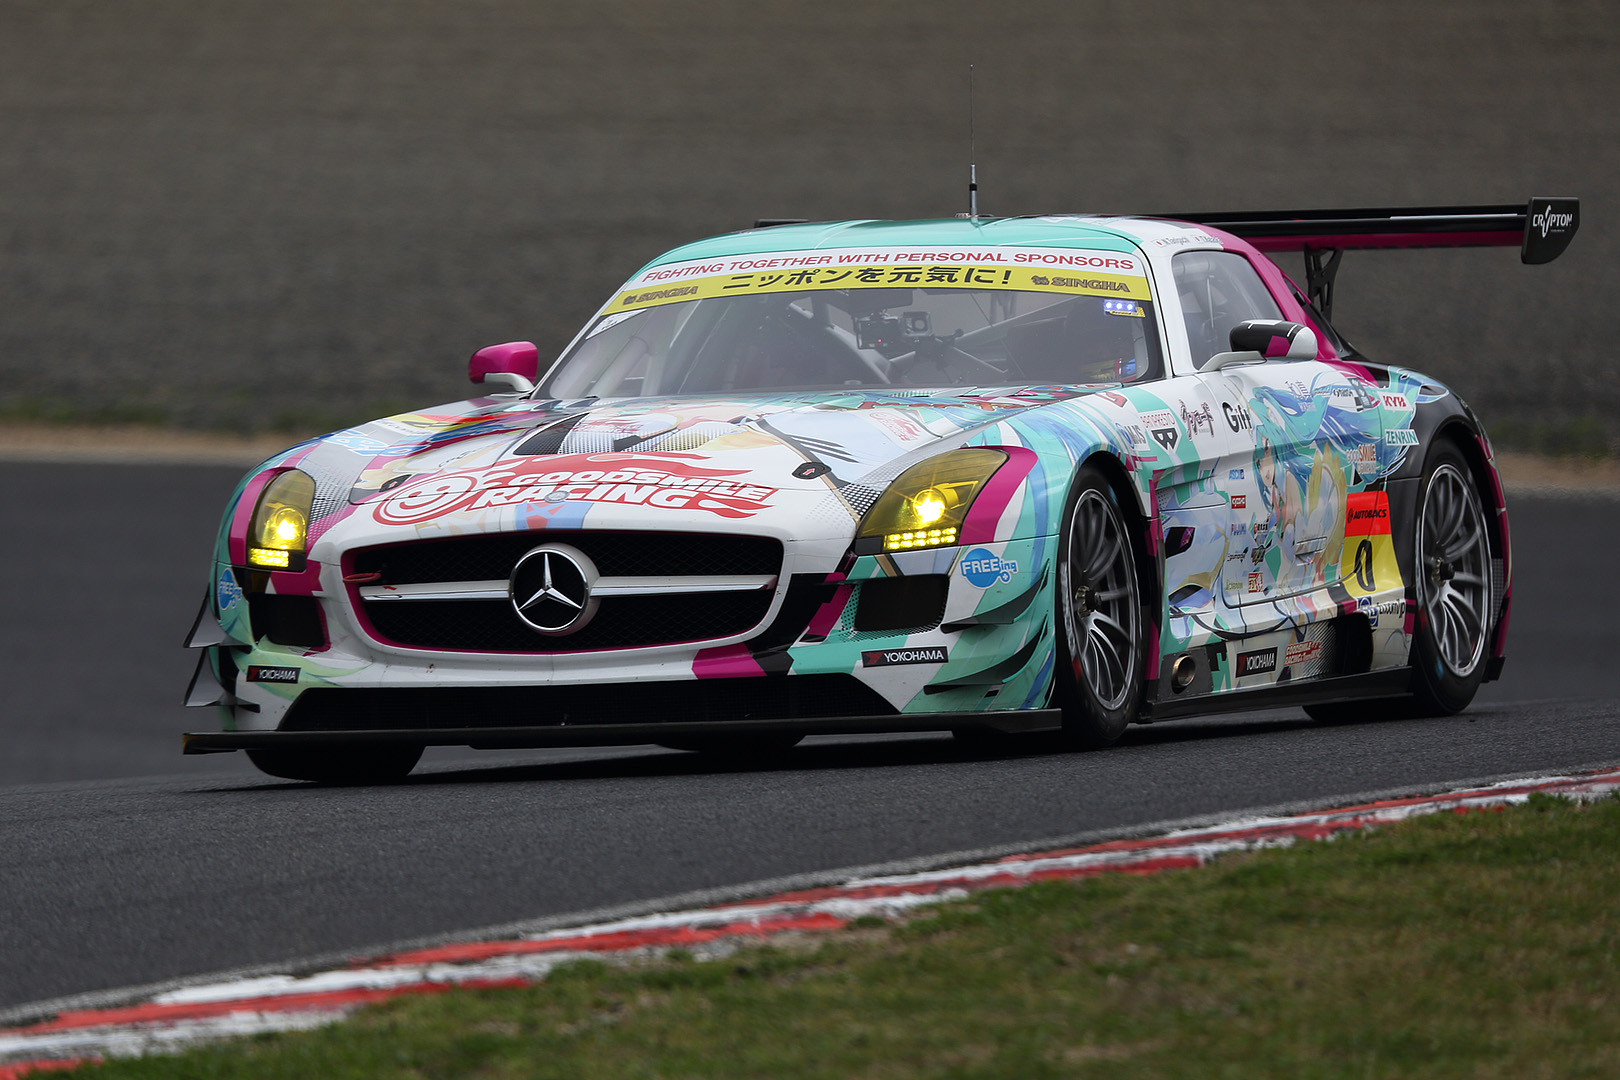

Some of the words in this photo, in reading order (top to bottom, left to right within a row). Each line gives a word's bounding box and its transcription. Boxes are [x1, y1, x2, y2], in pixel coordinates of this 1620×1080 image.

[642, 263, 725, 283] FIGHTING
[729, 255, 833, 271] TOGETHER
[838, 253, 890, 263] WITH
[893, 252, 1008, 263] PERSONAL
[1013, 253, 1135, 270] SPONSORS
[1050, 276, 1131, 293] SINGHA
[635, 285, 699, 303] SINGHA
[1221, 401, 1253, 433] Gift
[1385, 429, 1419, 445] ZENRIN
[1358, 444, 1376, 462] SMILE
[470, 483, 693, 510] RACING
[1353, 508, 1388, 520] AUTOBACS
[961, 558, 1018, 577] FREEing
[1354, 538, 1377, 592] 0
[883, 649, 945, 662] YOKOHAMA
[1245, 652, 1275, 671] YOKOHAMA
[259, 669, 297, 681] YOKOHAMA
